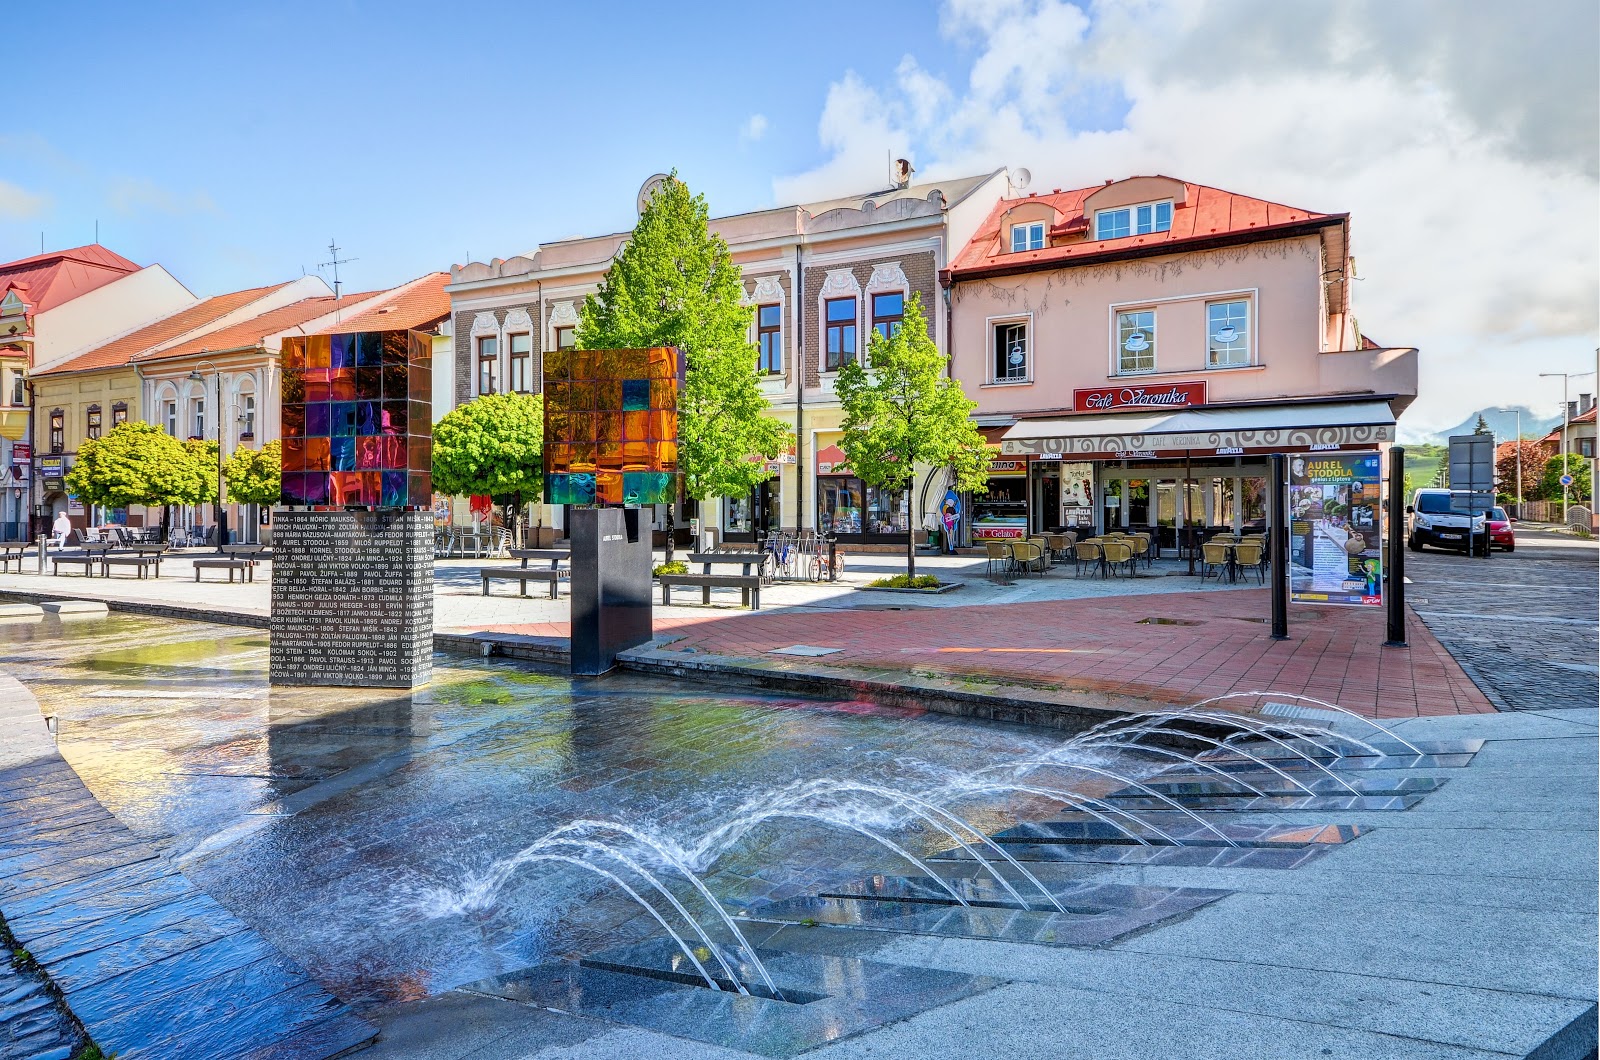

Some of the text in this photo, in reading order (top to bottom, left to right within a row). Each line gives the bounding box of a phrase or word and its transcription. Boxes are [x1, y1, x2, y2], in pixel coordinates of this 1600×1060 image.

[1086, 388, 1189, 410] Café Veronika
[1152, 436, 1201, 447] CAFÉ VERONIKA
[1216, 446, 1244, 454] LAVAZZA
[1308, 460, 1342, 470] AUREL
[1308, 469, 1353, 478] STODOLA
